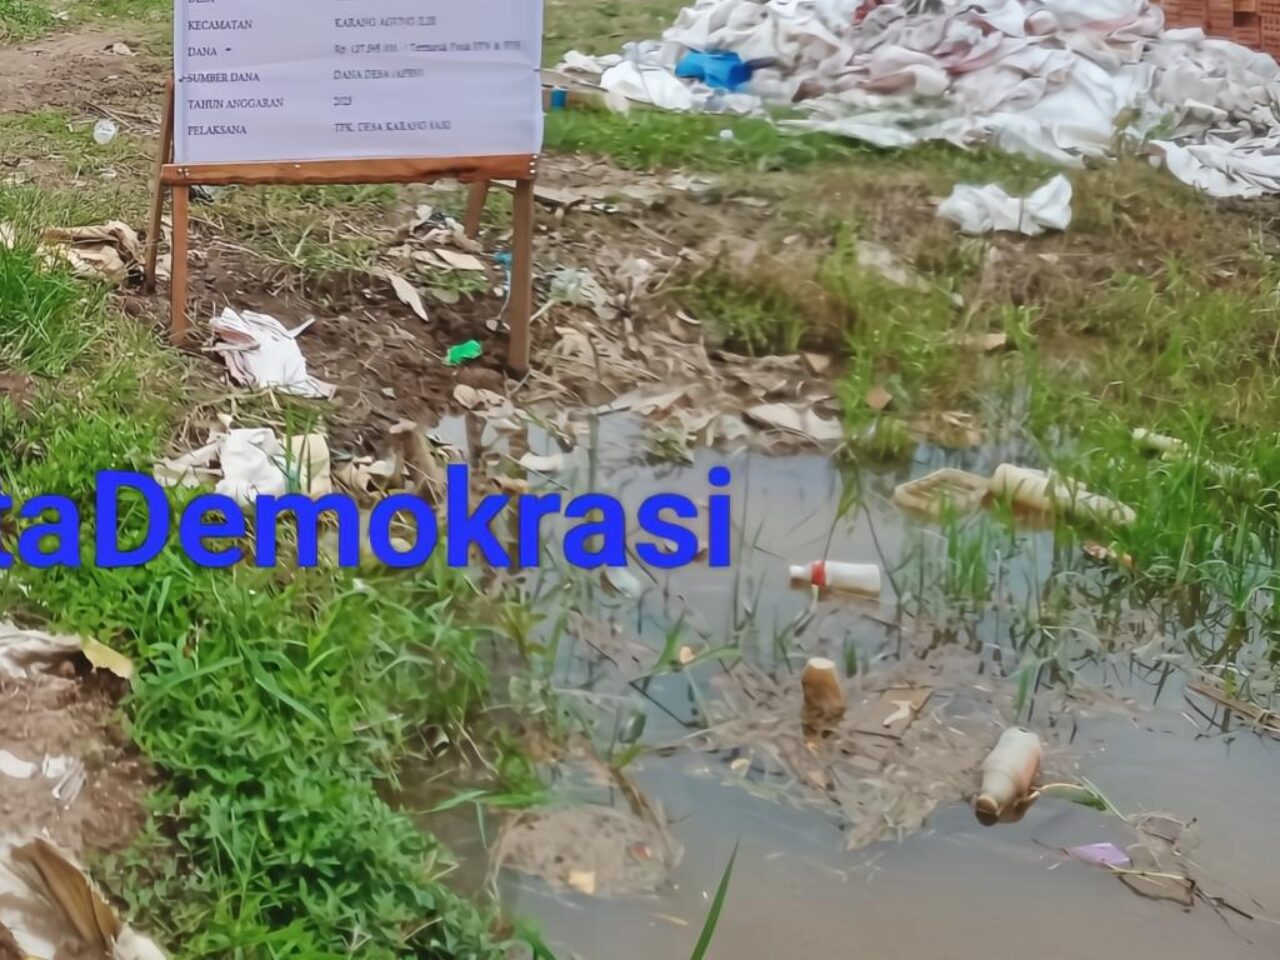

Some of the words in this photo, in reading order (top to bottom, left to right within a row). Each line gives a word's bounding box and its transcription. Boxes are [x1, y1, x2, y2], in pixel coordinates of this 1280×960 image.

[187, 20, 253, 31] KECAMATAN
[187, 46, 217, 57] DANA
[186, 73, 228, 83] SUMBER
[230, 72, 260, 82] DANA
[187, 99, 224, 110] TAHUN
[225, 98, 284, 109] ANGGARAN
[187, 125, 247, 136] PELAKSANA
